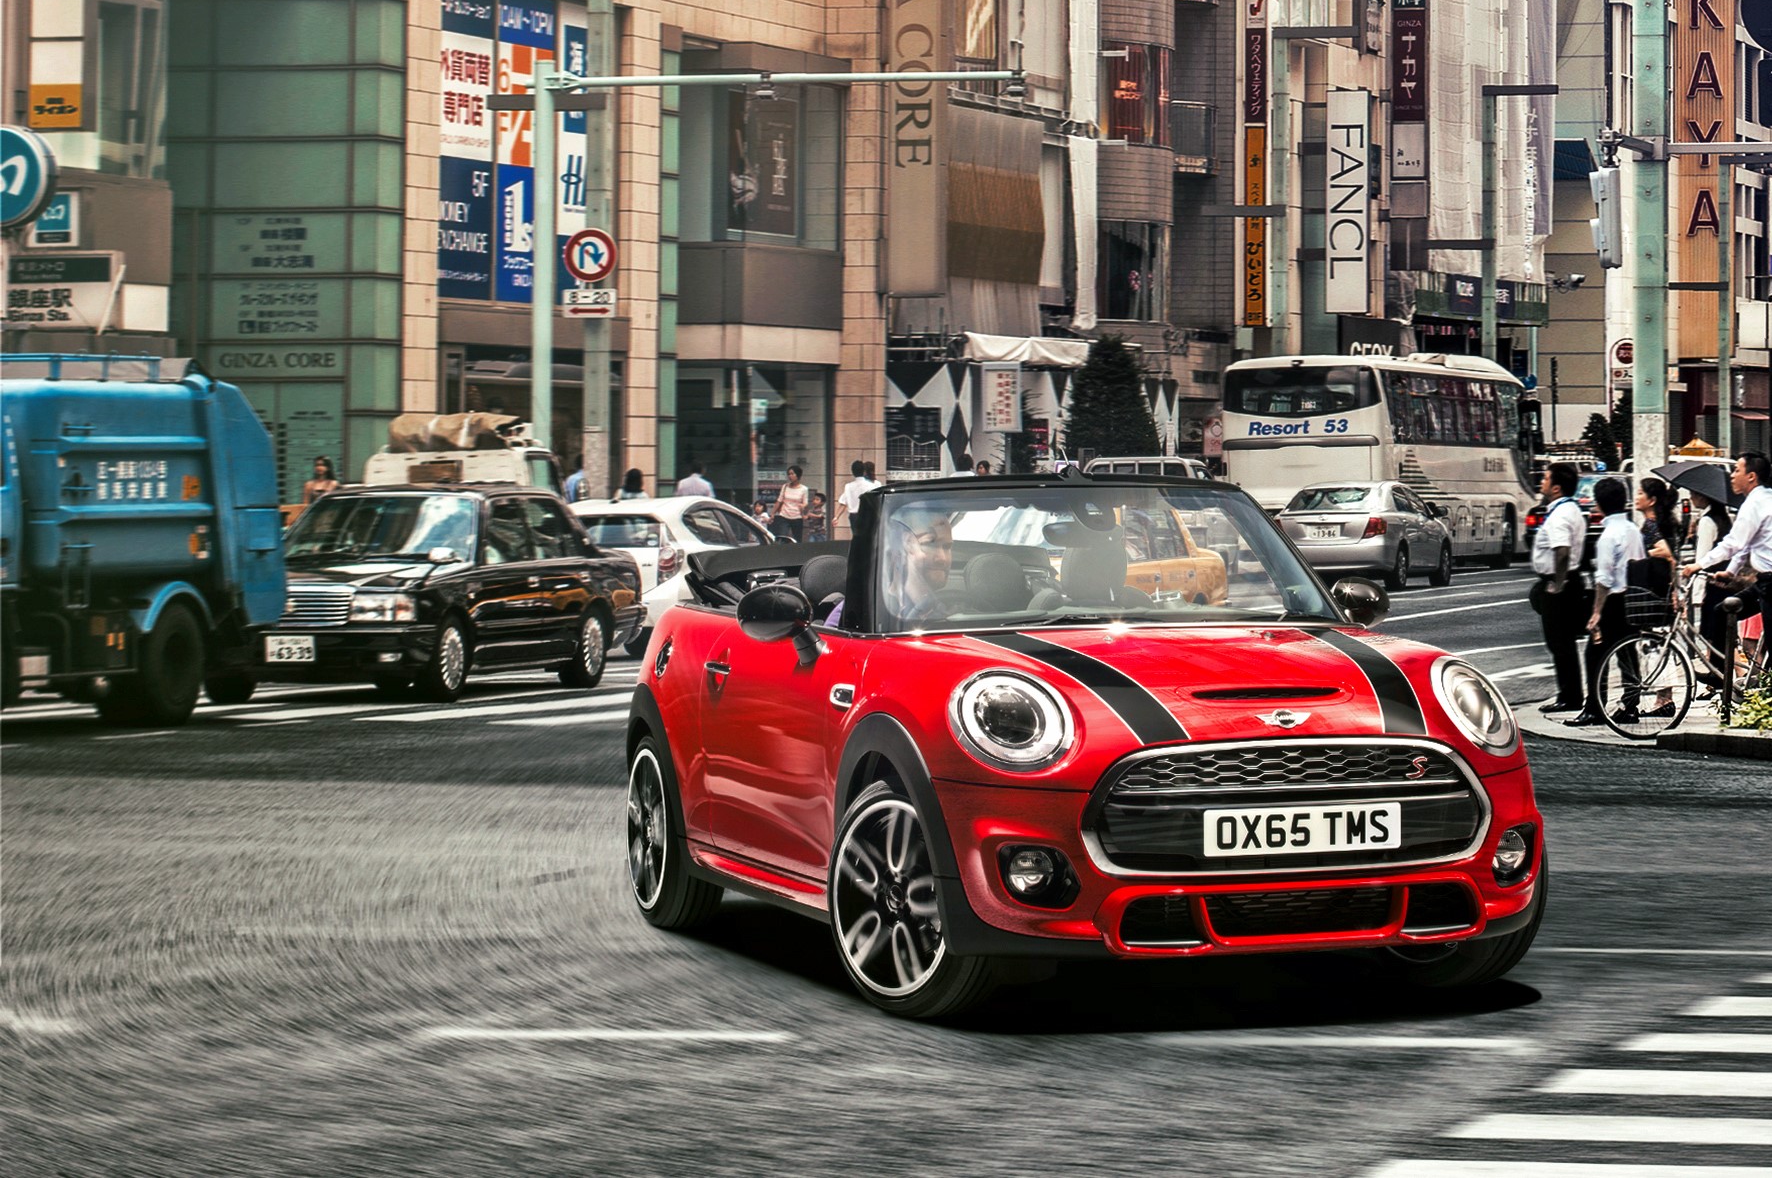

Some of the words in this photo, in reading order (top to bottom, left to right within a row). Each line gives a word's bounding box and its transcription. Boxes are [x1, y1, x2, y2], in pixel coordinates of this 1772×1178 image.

[1400, 31, 1417, 99] ナカヤ
[894, 22, 935, 169] CORE
[1329, 123, 1364, 280] FANCL
[7, 288, 74, 309] 銀座駅
[219, 353, 278, 369] GINZA
[284, 353, 337, 369] CORE
[1248, 420, 1311, 436] Resort
[1323, 418, 1349, 434] 53
[1216, 812, 1311, 851] OX65
[1322, 809, 1390, 846] TMS
